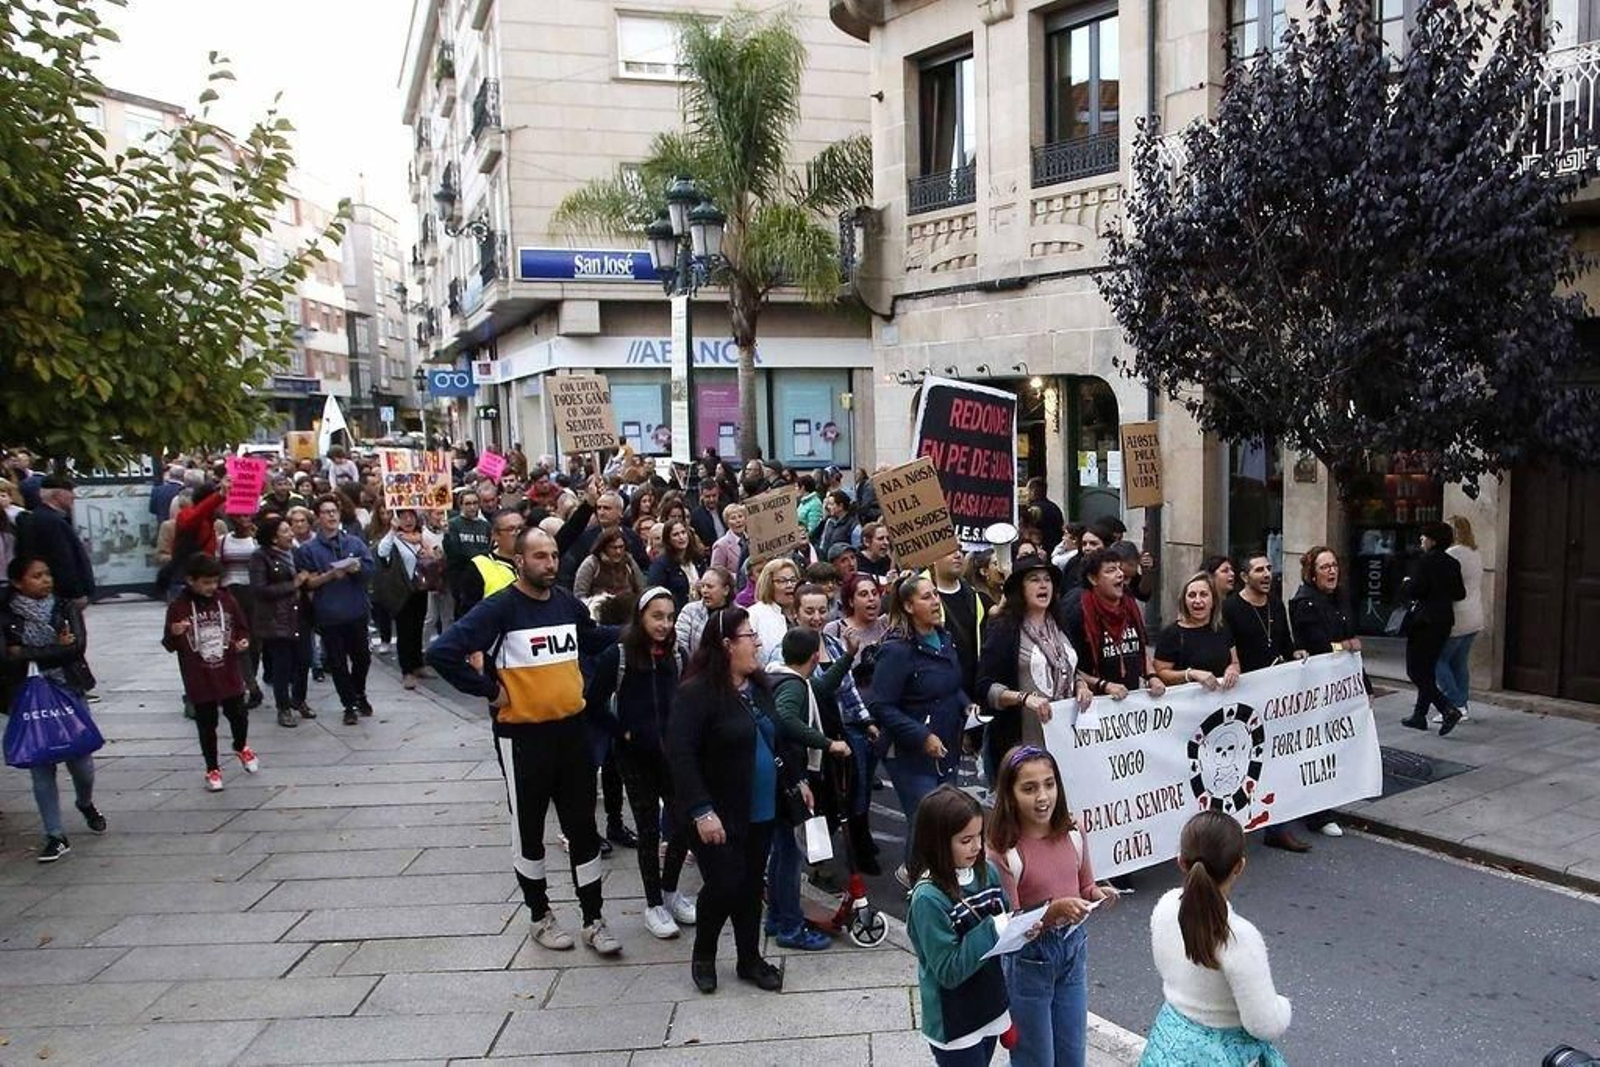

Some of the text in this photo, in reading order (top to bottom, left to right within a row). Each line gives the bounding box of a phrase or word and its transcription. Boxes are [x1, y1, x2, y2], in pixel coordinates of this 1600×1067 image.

[574, 253, 634, 275] San José
[566, 418, 604, 432] SEMPRE
[573, 433, 615, 448] PERDES
[945, 444, 969, 475] PE
[970, 446, 989, 478] DE
[1137, 462, 1157, 475] TUA
[880, 465, 935, 495] NA NOSA
[886, 494, 921, 515] VILA
[953, 491, 980, 517] CASA
[889, 506, 948, 539] NON SODES
[895, 524, 954, 557] BENVIDOS
[530, 632, 576, 656] FILA
[1263, 672, 1364, 722] CASAS DE APOSTAS
[1095, 709, 1148, 743] NEGOCIO
[1152, 705, 1173, 731] DO
[1272, 715, 1356, 758] FORA DA NOSA
[1108, 749, 1145, 781] XOGO
[1299, 753, 1336, 786] VILA!!
[1082, 782, 1185, 834] BANCA SEMPRE
[1113, 829, 1153, 865] GAÑA
